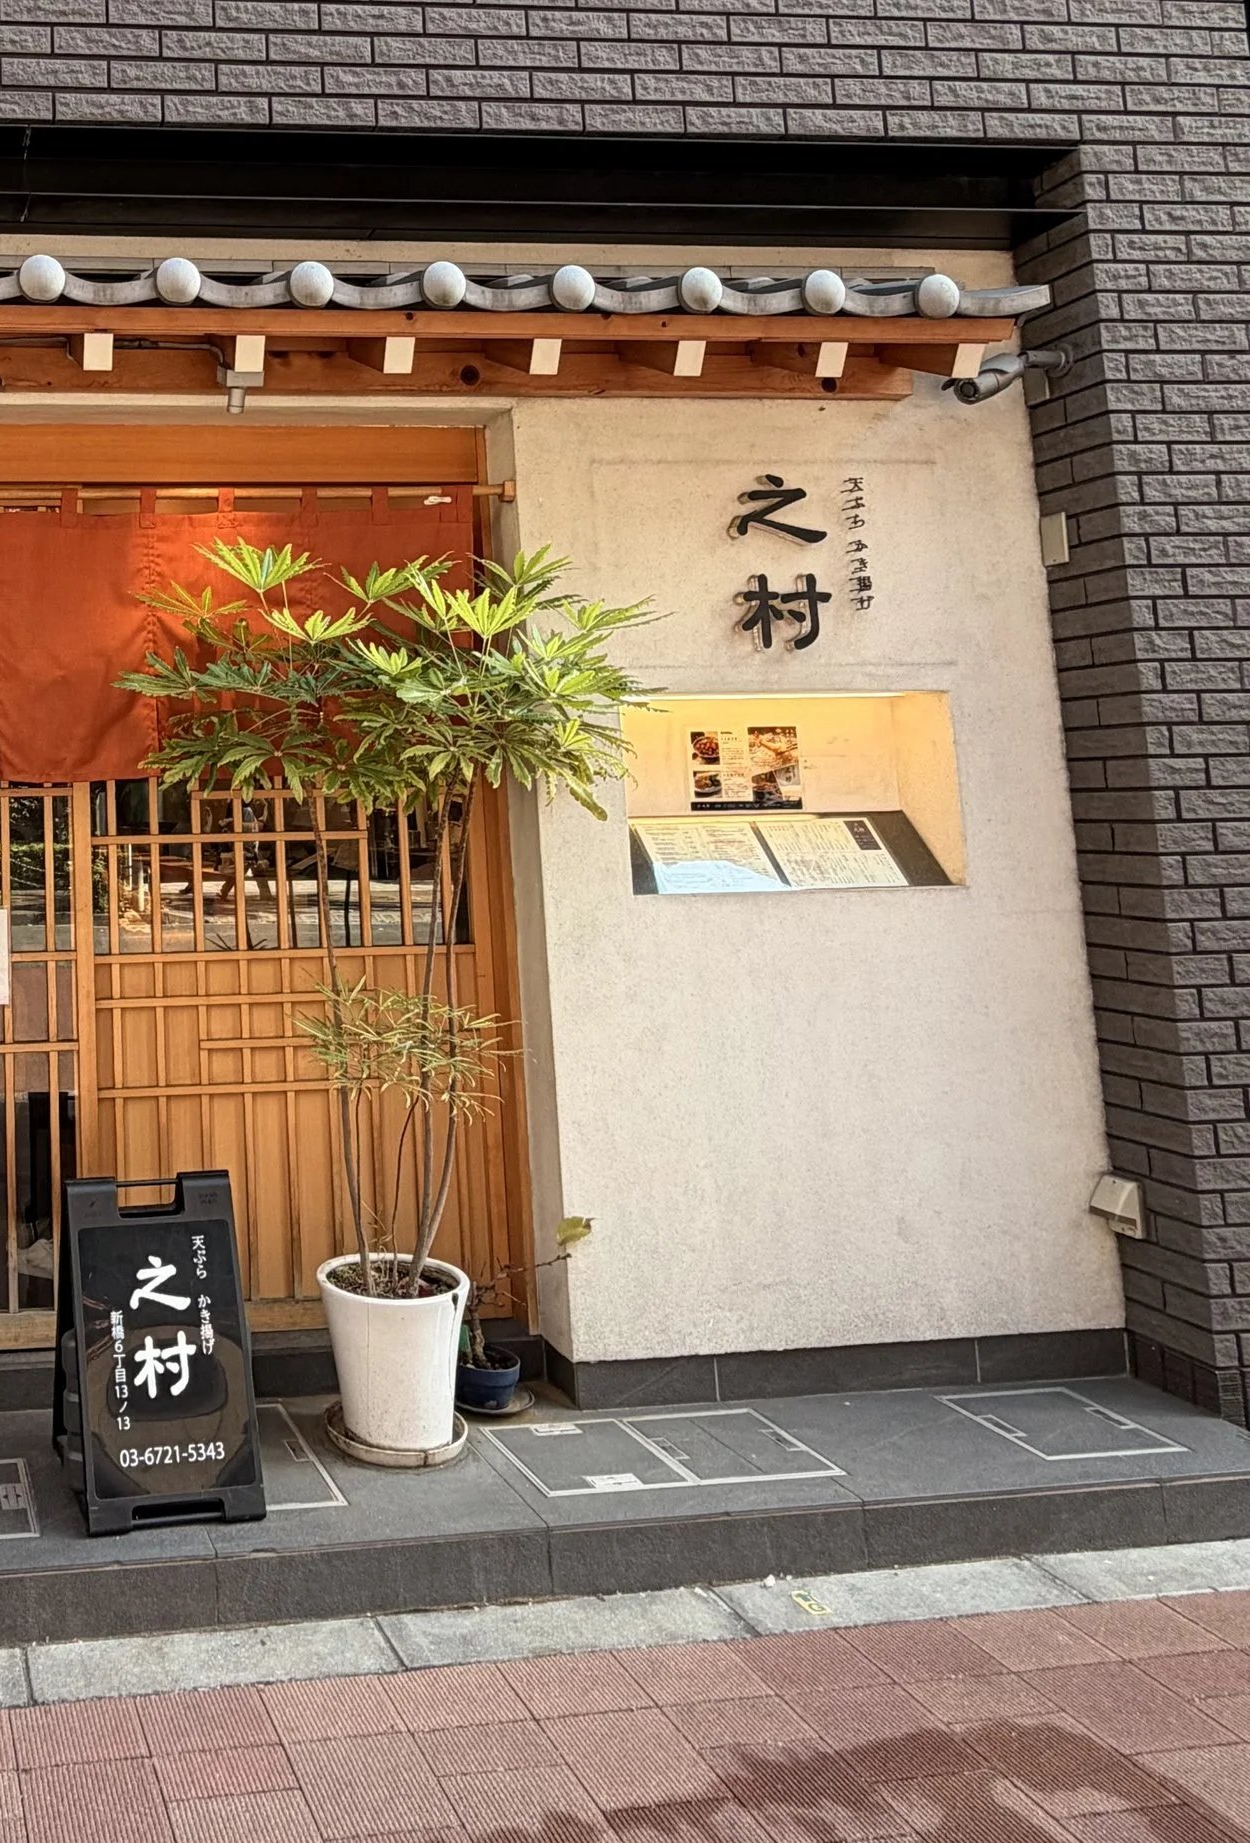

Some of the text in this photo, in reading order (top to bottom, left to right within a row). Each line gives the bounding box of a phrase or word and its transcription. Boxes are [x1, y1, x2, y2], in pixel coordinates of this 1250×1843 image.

[737, 474, 832, 650] 之村
[129, 1254, 197, 1400] 之村
[191, 1234, 216, 1356] 天ぷら かき揚げ
[119, 1441, 226, 1469] 03-6721-5343
